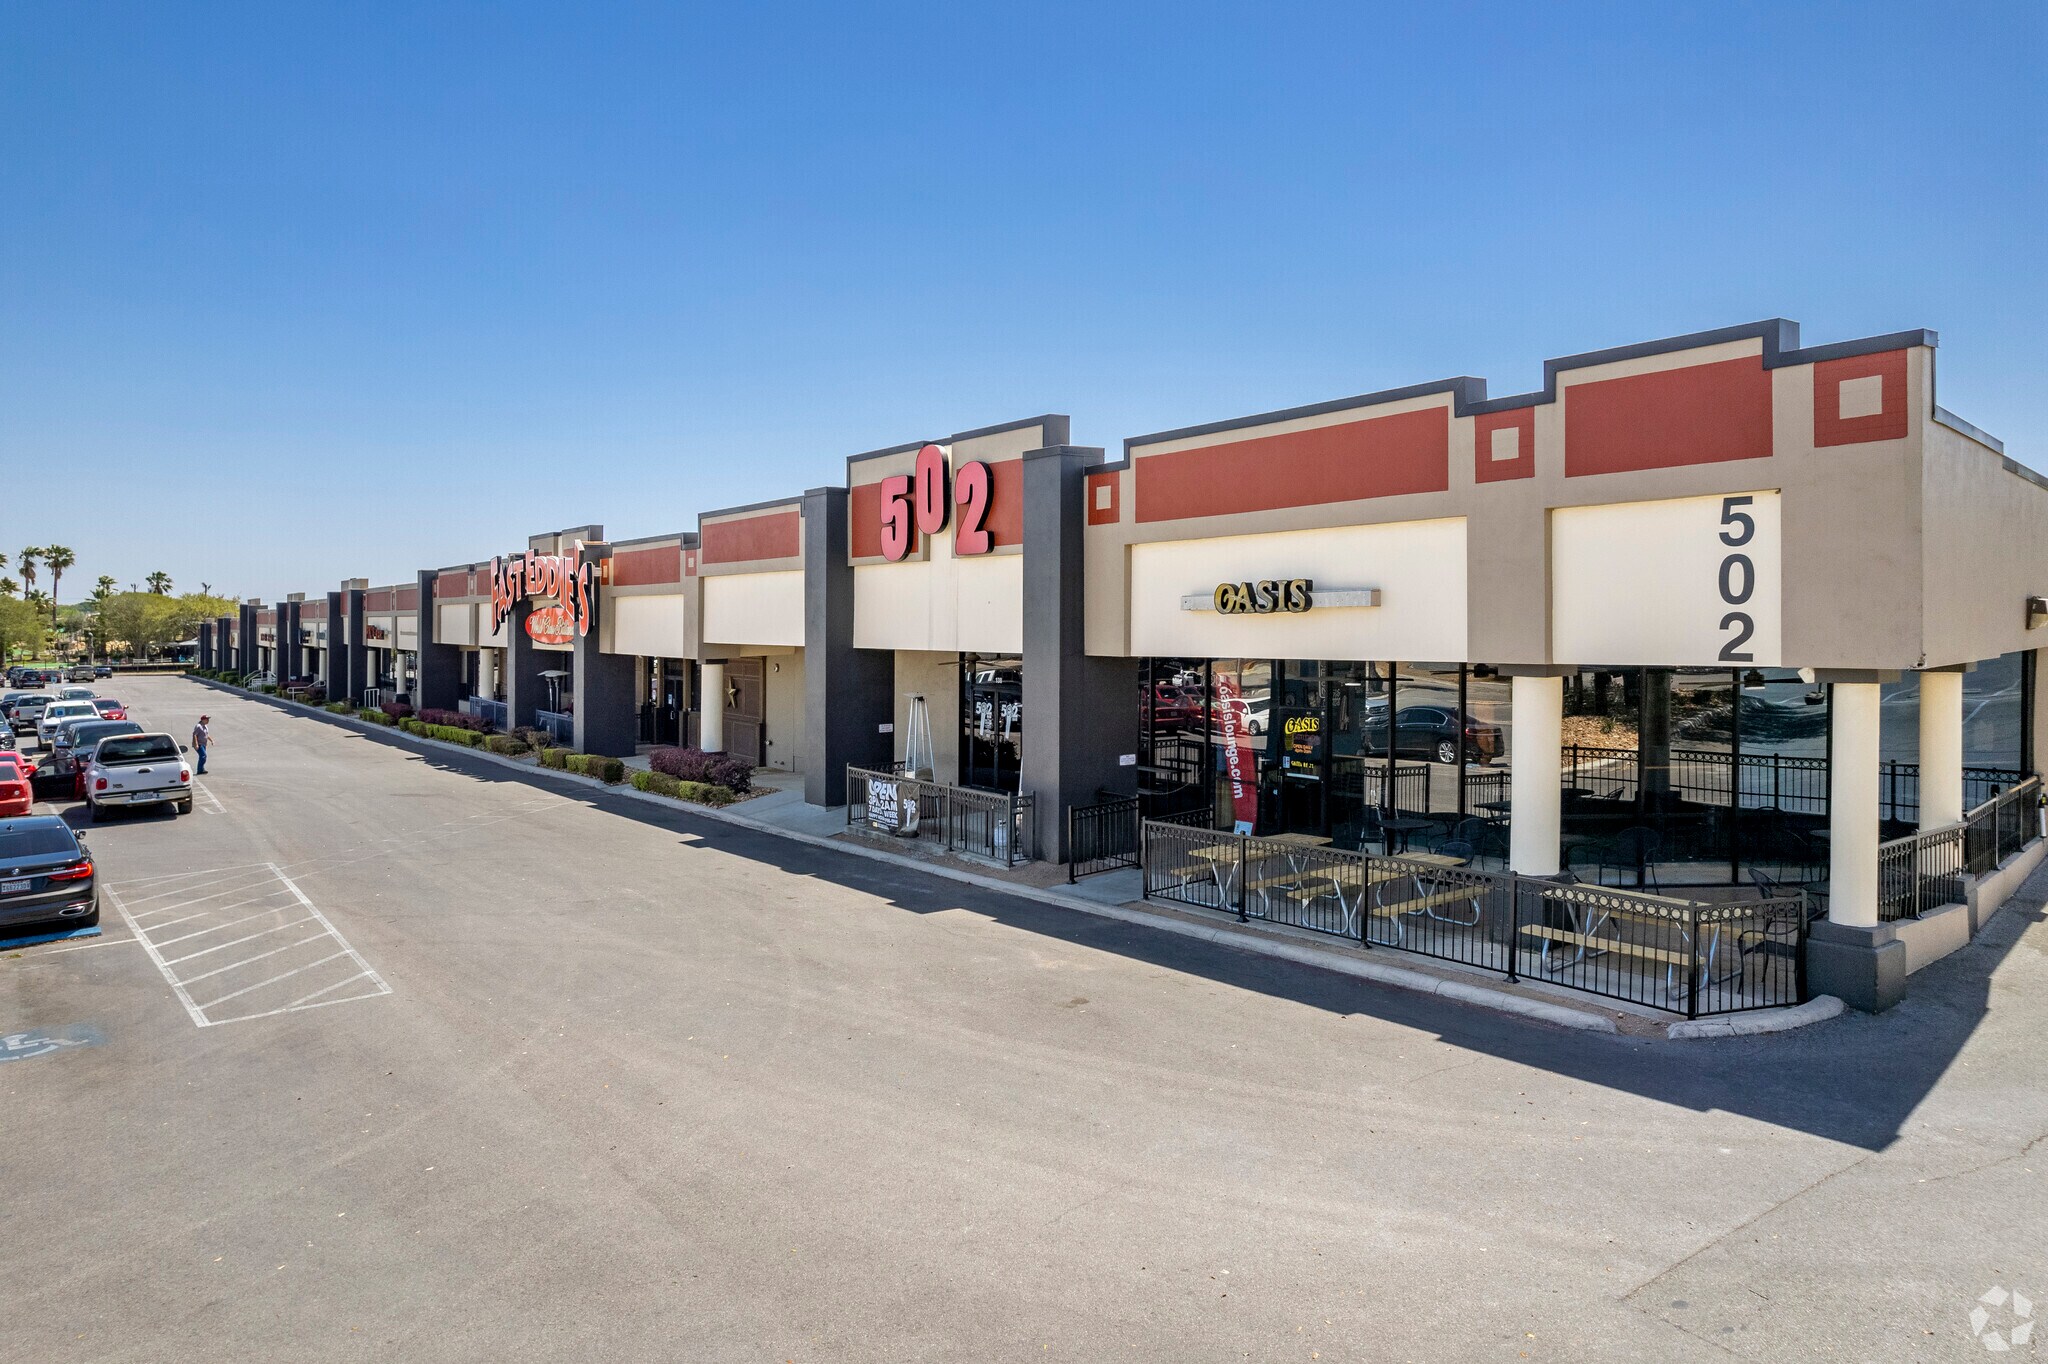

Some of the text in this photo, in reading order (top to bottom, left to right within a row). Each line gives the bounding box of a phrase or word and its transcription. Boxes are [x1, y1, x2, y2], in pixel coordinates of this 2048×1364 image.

[881, 443, 994, 562] 502
[490, 540, 590, 637] FAST EDDIE'S
[1214, 579, 1313, 614] OASIS
[1718, 496, 1755, 662] 502
[1285, 717, 1320, 734] OASIS
[869, 779, 897, 800] OPEN
